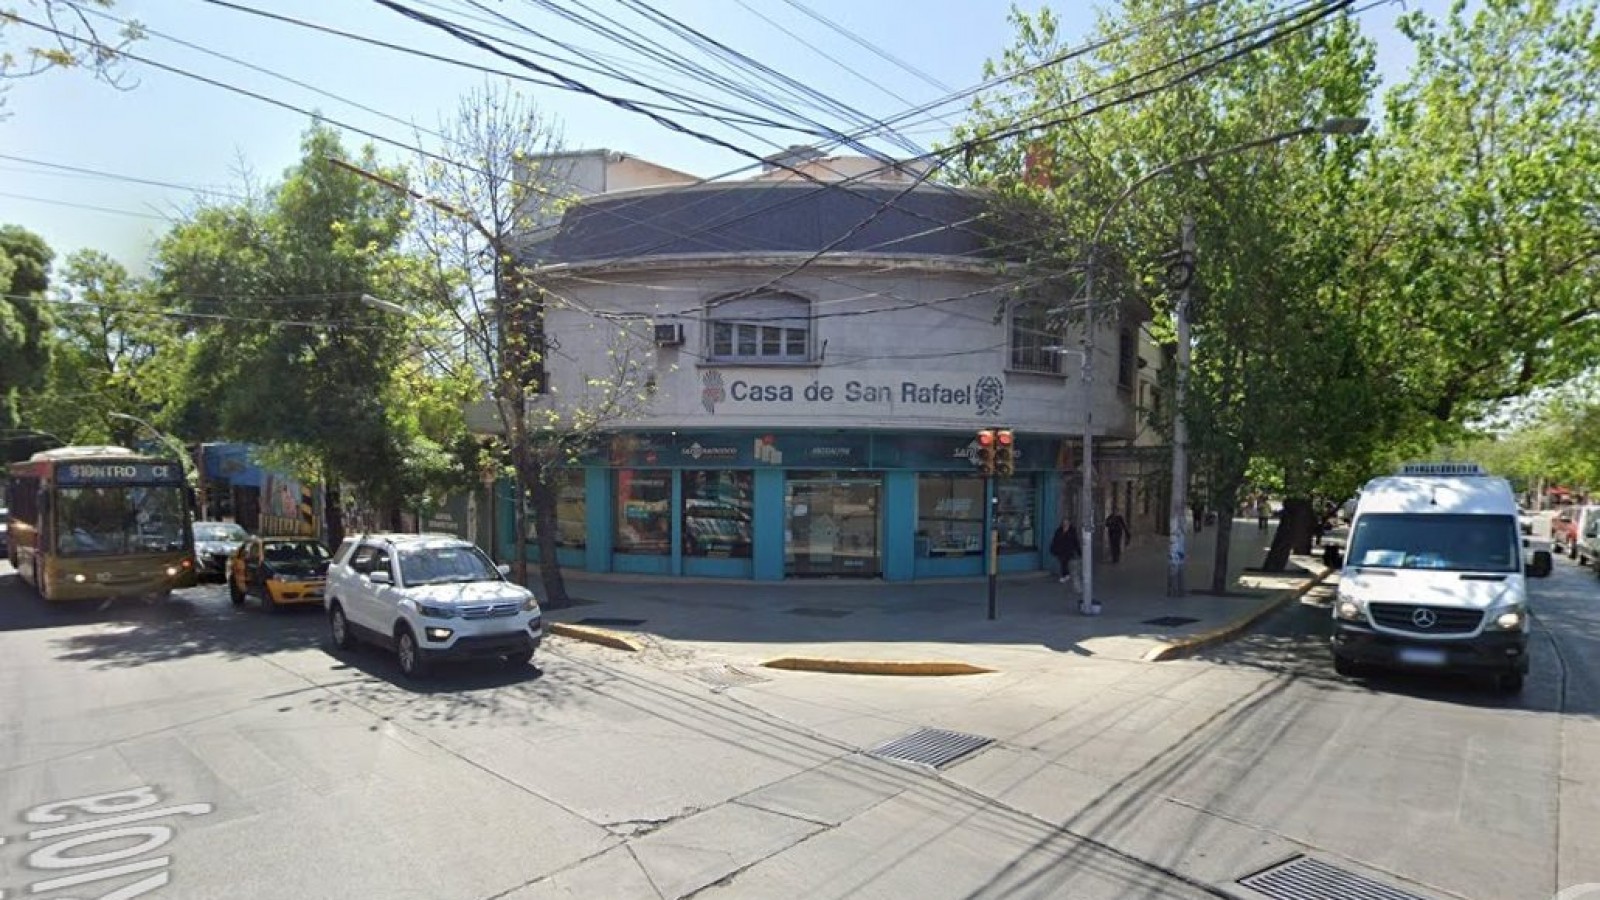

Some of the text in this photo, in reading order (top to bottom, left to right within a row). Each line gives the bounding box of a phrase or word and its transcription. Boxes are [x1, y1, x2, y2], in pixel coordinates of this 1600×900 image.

[730, 379, 971, 405] Casa de San Rafael
